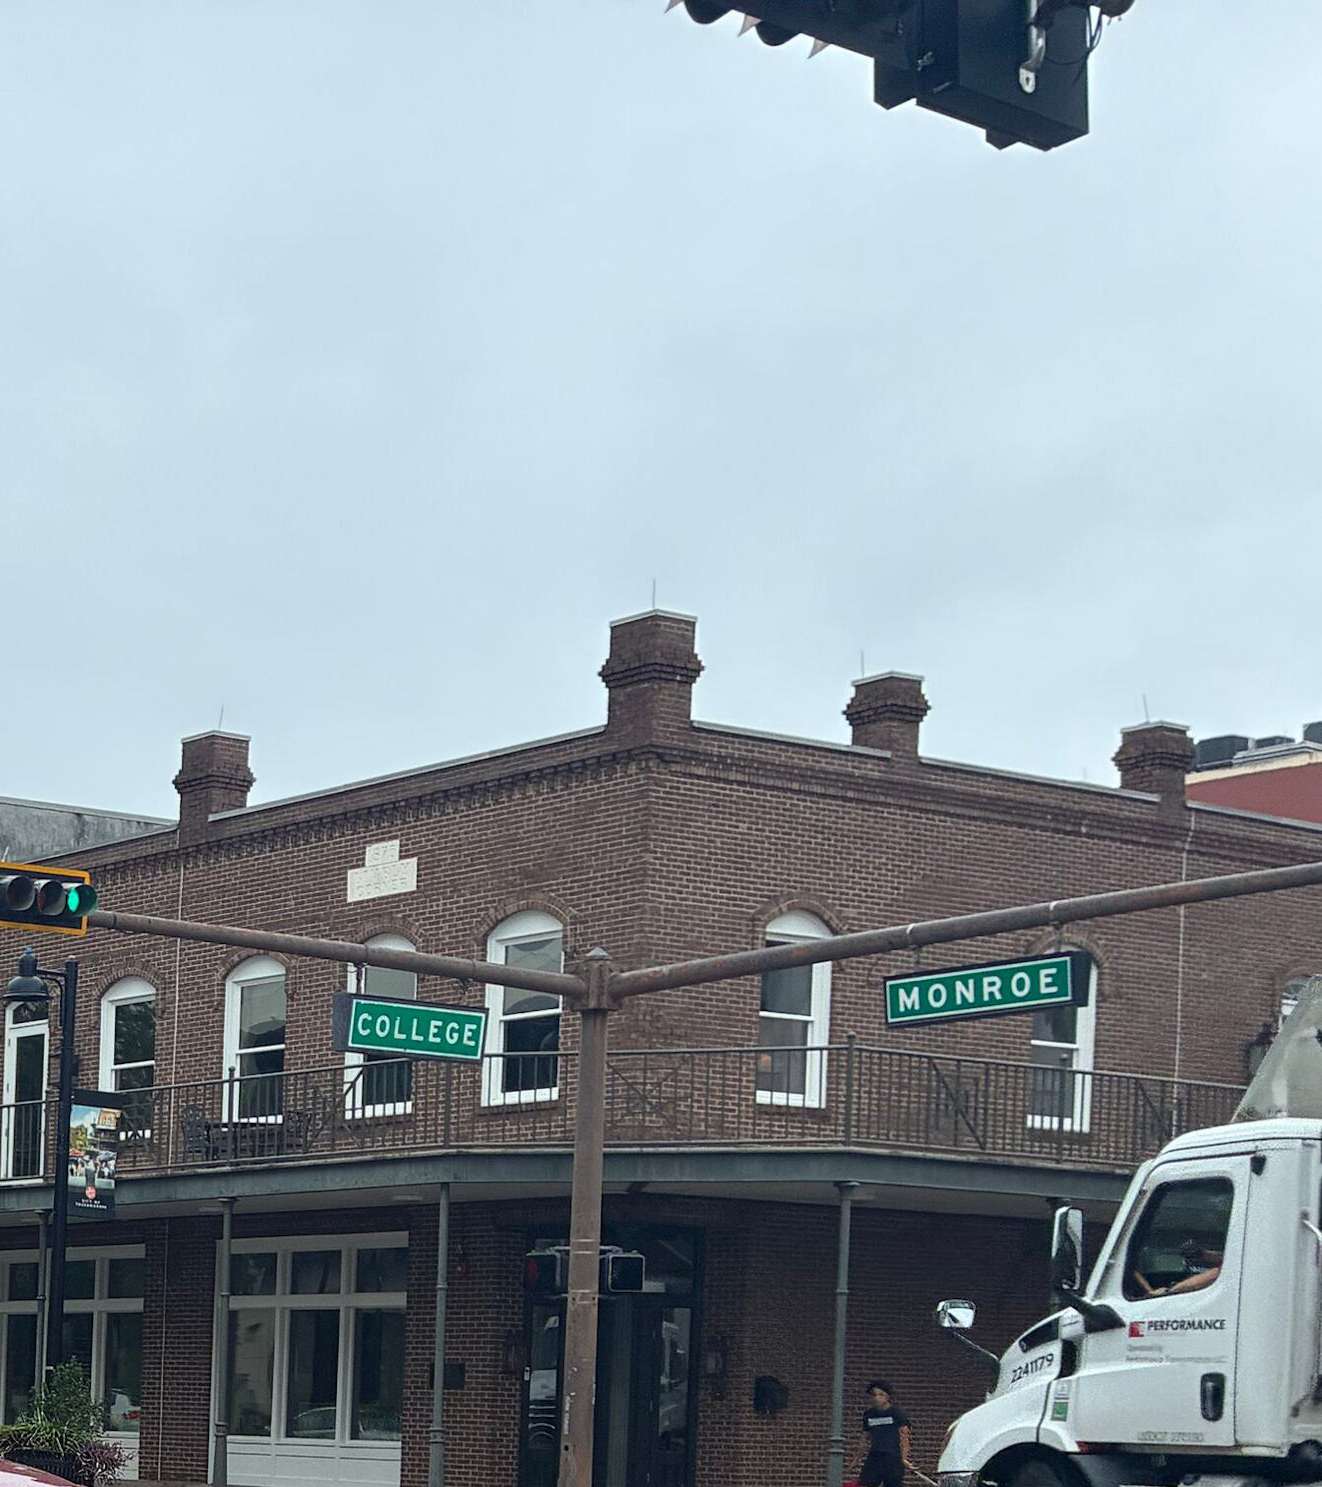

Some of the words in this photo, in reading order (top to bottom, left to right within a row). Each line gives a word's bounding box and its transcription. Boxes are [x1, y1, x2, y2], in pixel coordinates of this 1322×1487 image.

[898, 968, 1059, 1013] MONROE
[357, 1013, 478, 1047] COLLEGE
[1147, 1319, 1226, 1331] PERFORMANCE
[1010, 1353, 1054, 1384] 2241179
